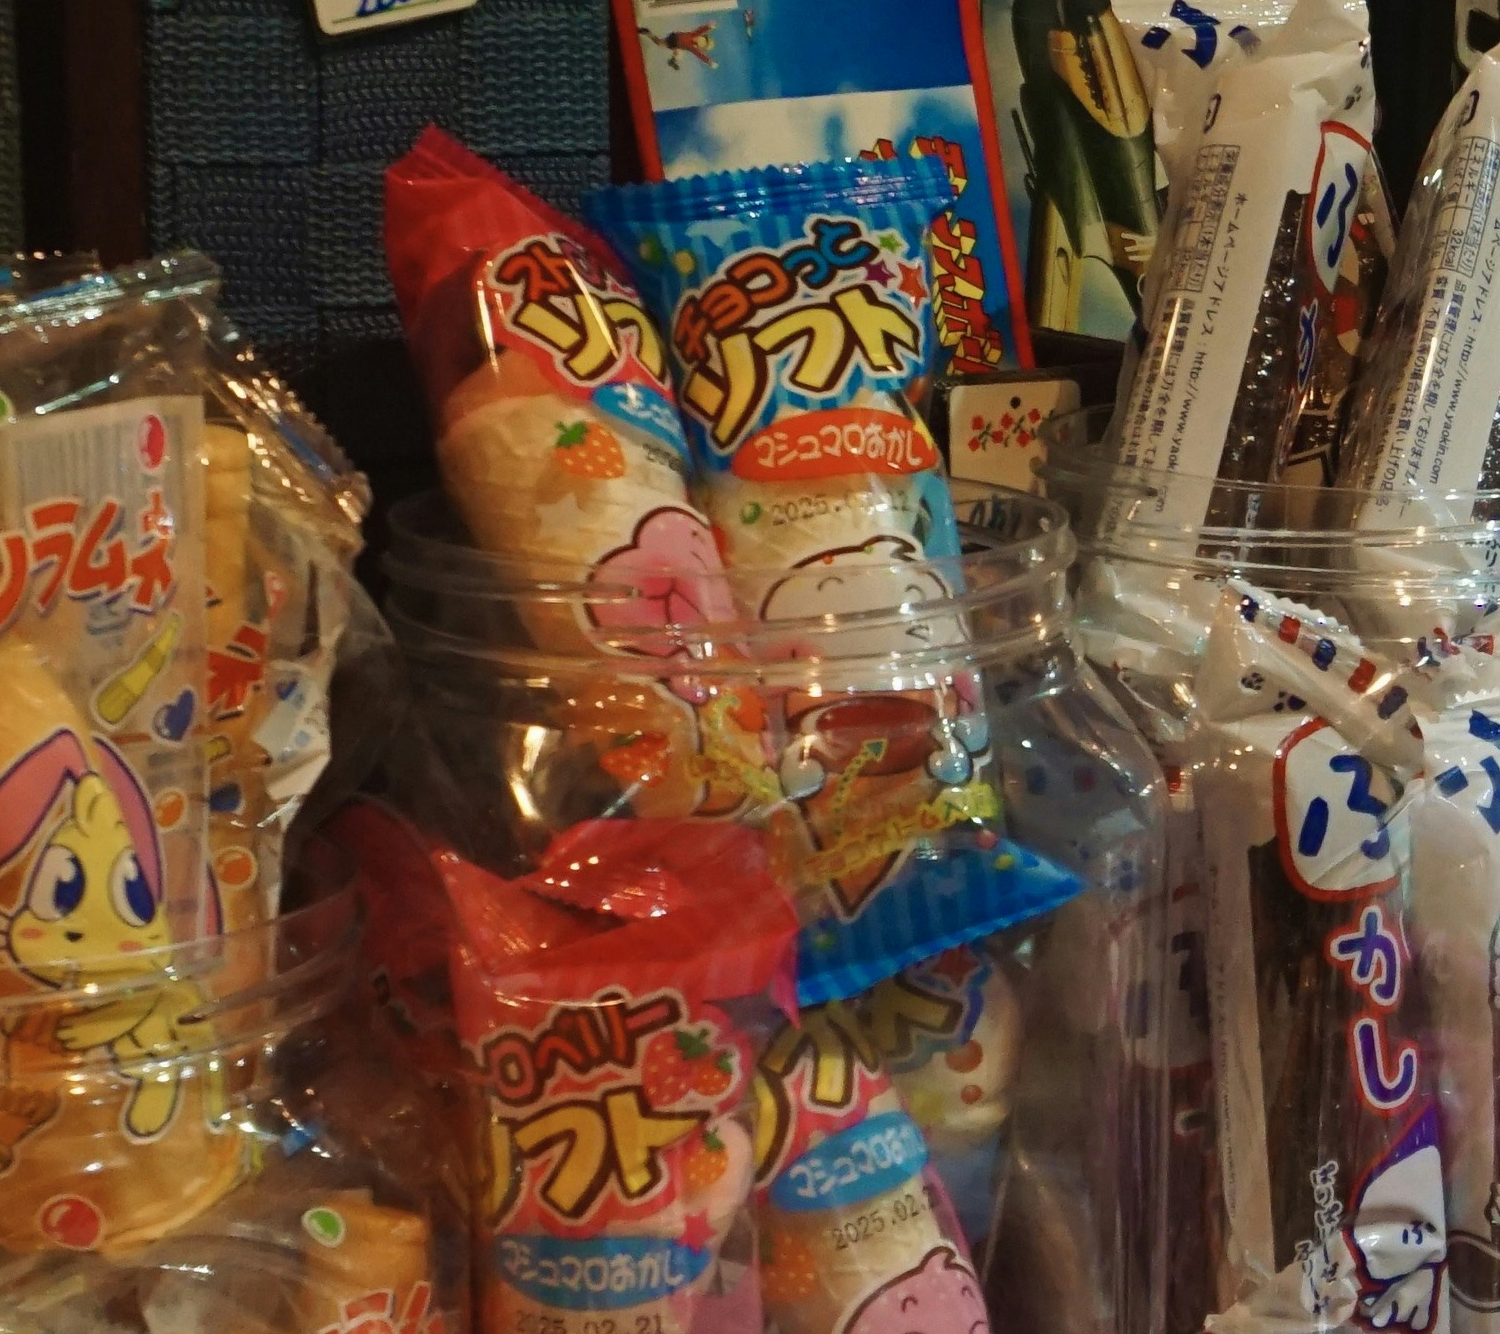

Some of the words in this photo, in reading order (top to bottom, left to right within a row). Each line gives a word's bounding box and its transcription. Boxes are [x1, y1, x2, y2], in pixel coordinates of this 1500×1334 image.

[683, 283, 921, 450] ソフト
[754, 423, 924, 470] マシュマロおかし
